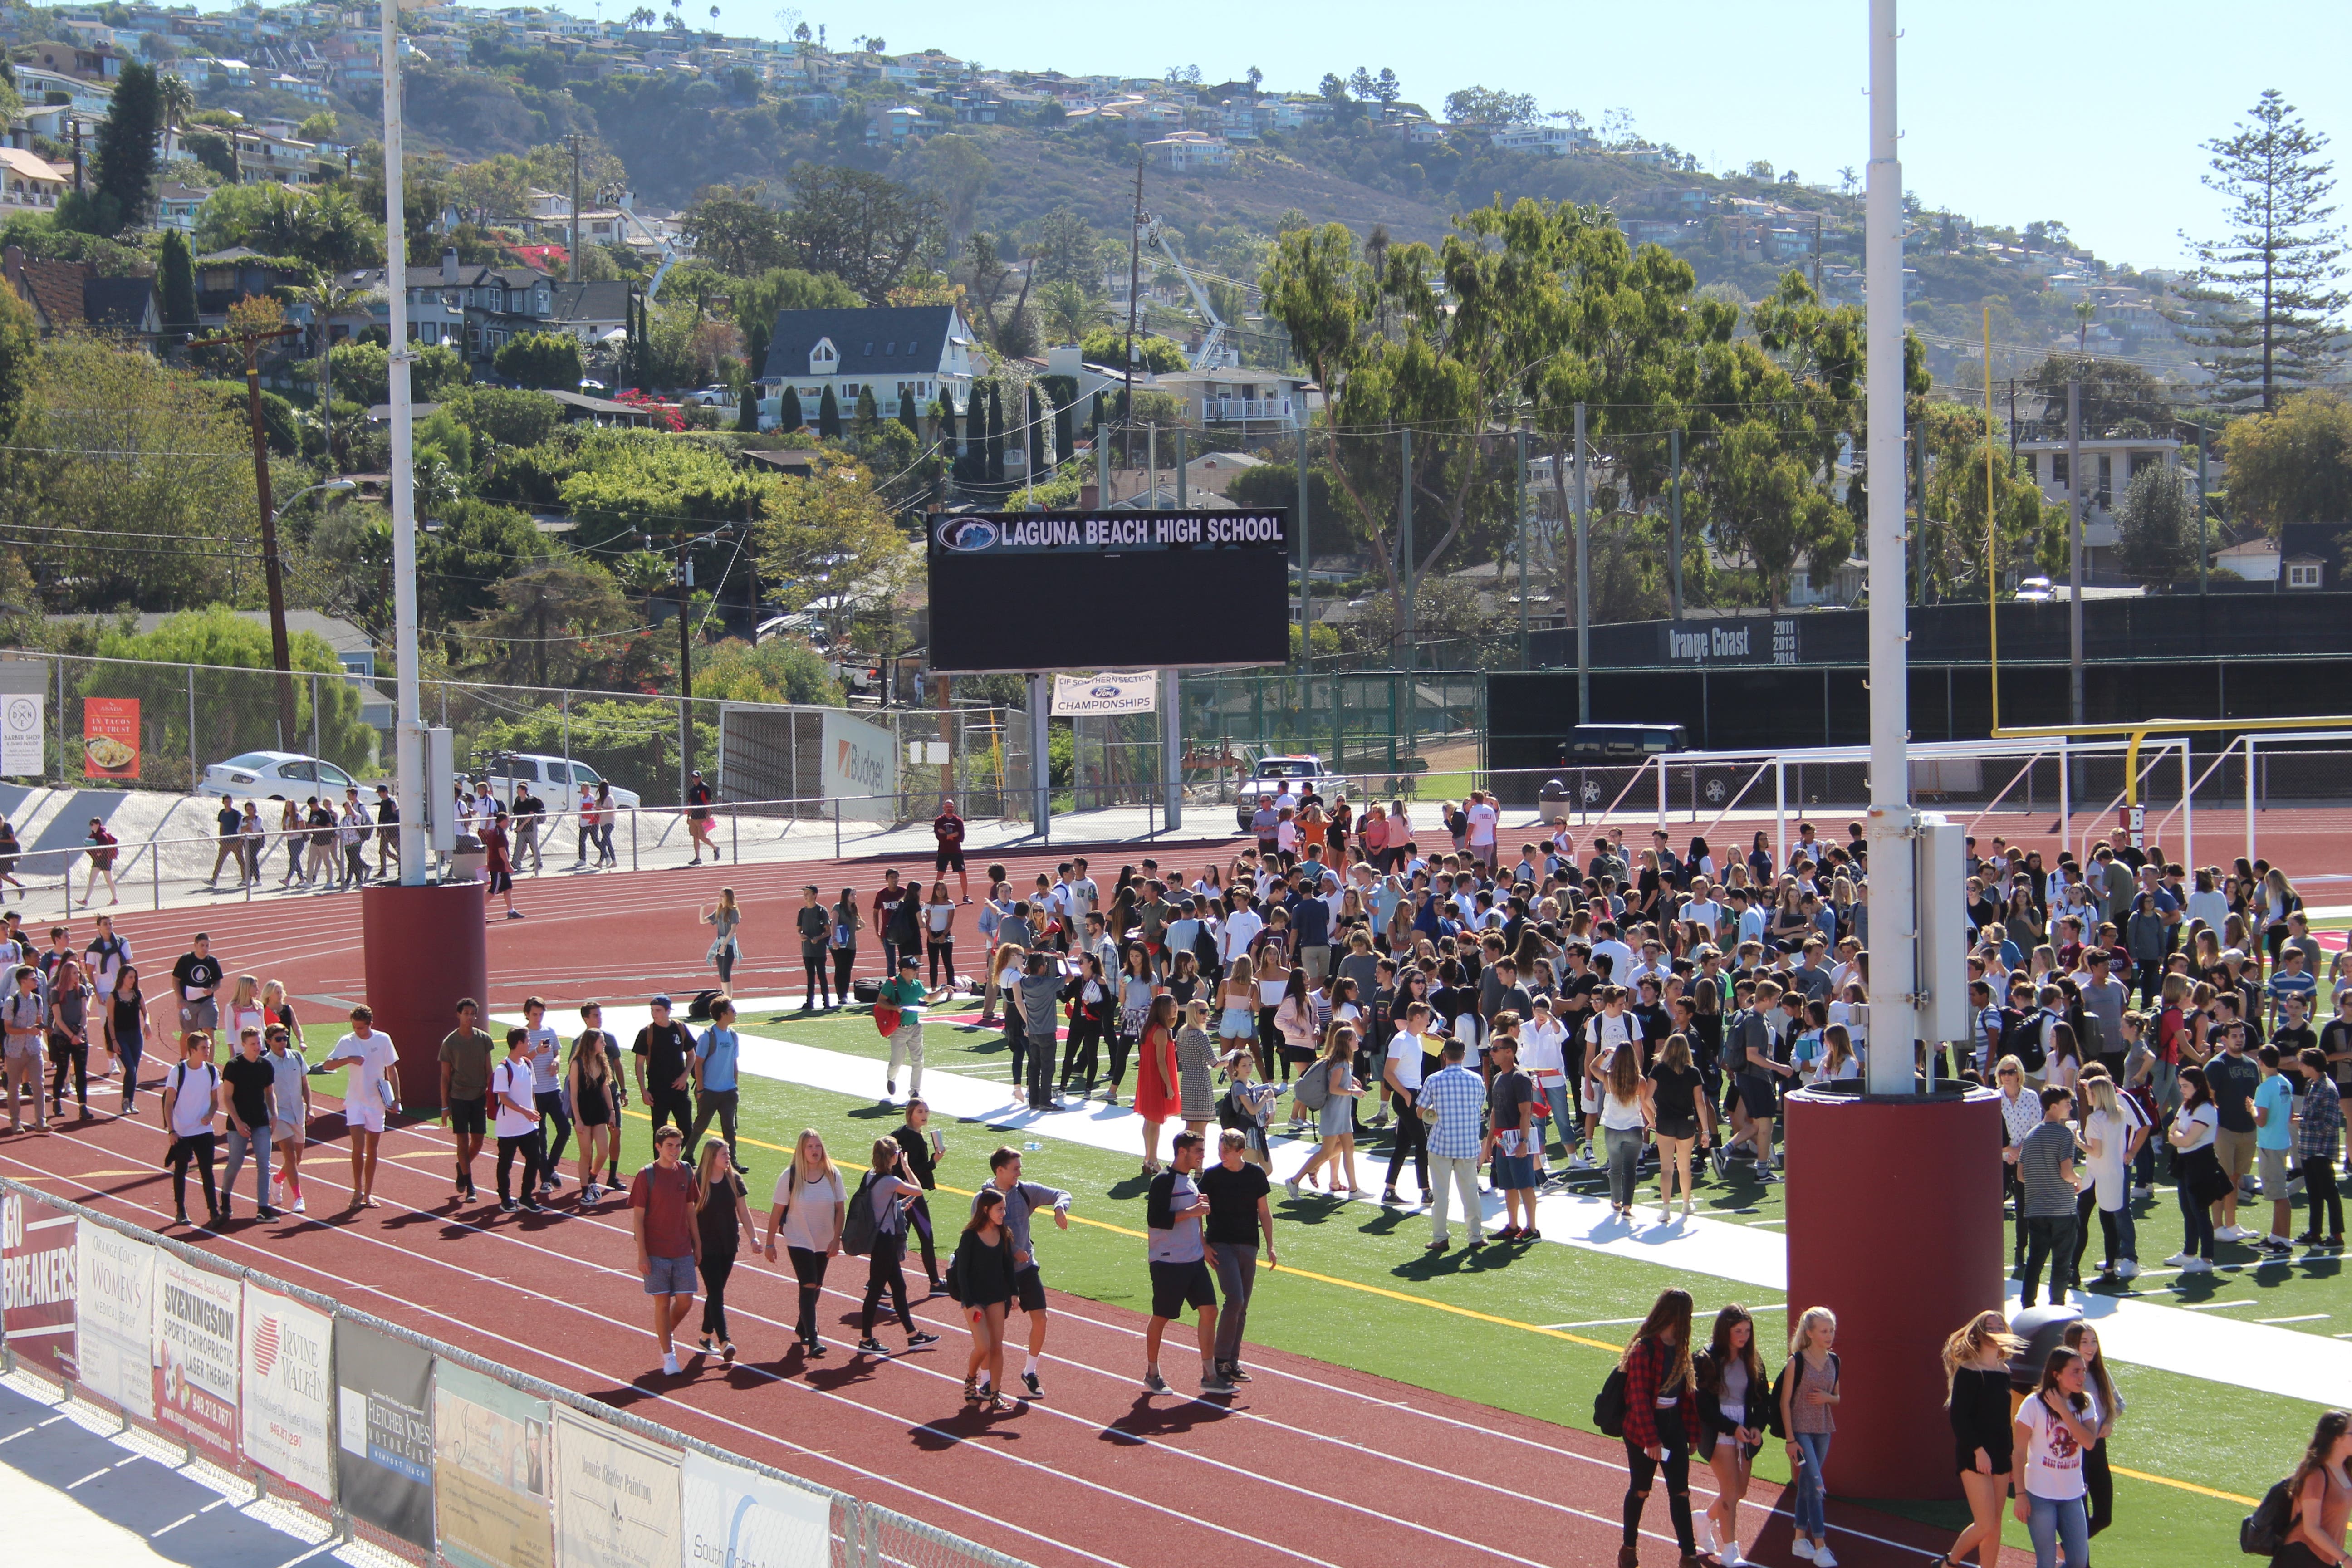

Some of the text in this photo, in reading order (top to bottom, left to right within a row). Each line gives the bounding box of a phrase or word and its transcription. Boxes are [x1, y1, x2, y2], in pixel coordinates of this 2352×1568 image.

[1002, 517, 1283, 545] LAGUNA BEACH HIGH SCHOOL
[1669, 626, 1749, 662] Orange Coast
[1773, 620, 1793, 635] 2011
[1773, 636, 1795, 651] 2013
[1773, 652, 1795, 664] 2014
[1073, 676, 1117, 686] SOUTHERN
[1119, 674, 1152, 683] SECTION
[1096, 686, 1115, 697] Ford
[1058, 697, 1150, 710] CHAMPIONSHIPS
[851, 744, 884, 796] Budget
[3, 1194, 22, 1249] GO
[93, 1235, 138, 1267] ORANGE COAST
[3, 1245, 76, 1310] BREAKERS
[92, 1258, 141, 1309] WOMEN'S
[95, 1301, 136, 1329] MEDICAL GROUP
[165, 1282, 234, 1343] SVENINGSON
[164, 1318, 186, 1345] SPORTS
[188, 1329, 233, 1367] CHIROPRACTIC
[283, 1323, 318, 1368] IRVINE
[186, 1352, 233, 1393] LASER THERAPY
[280, 1355, 324, 1405] WALK-IN
[192, 1393, 232, 1430] 949.218.7671
[368, 1397, 431, 1446] FLETCHER JONES
[374, 1450, 402, 1468] NEWPORT
[2043, 1455, 2055, 1469] WEST
[582, 1454, 652, 1505] Dennis Shaffer Painting
[603, 1553, 611, 1564] For
[694, 1534, 724, 1568] South
